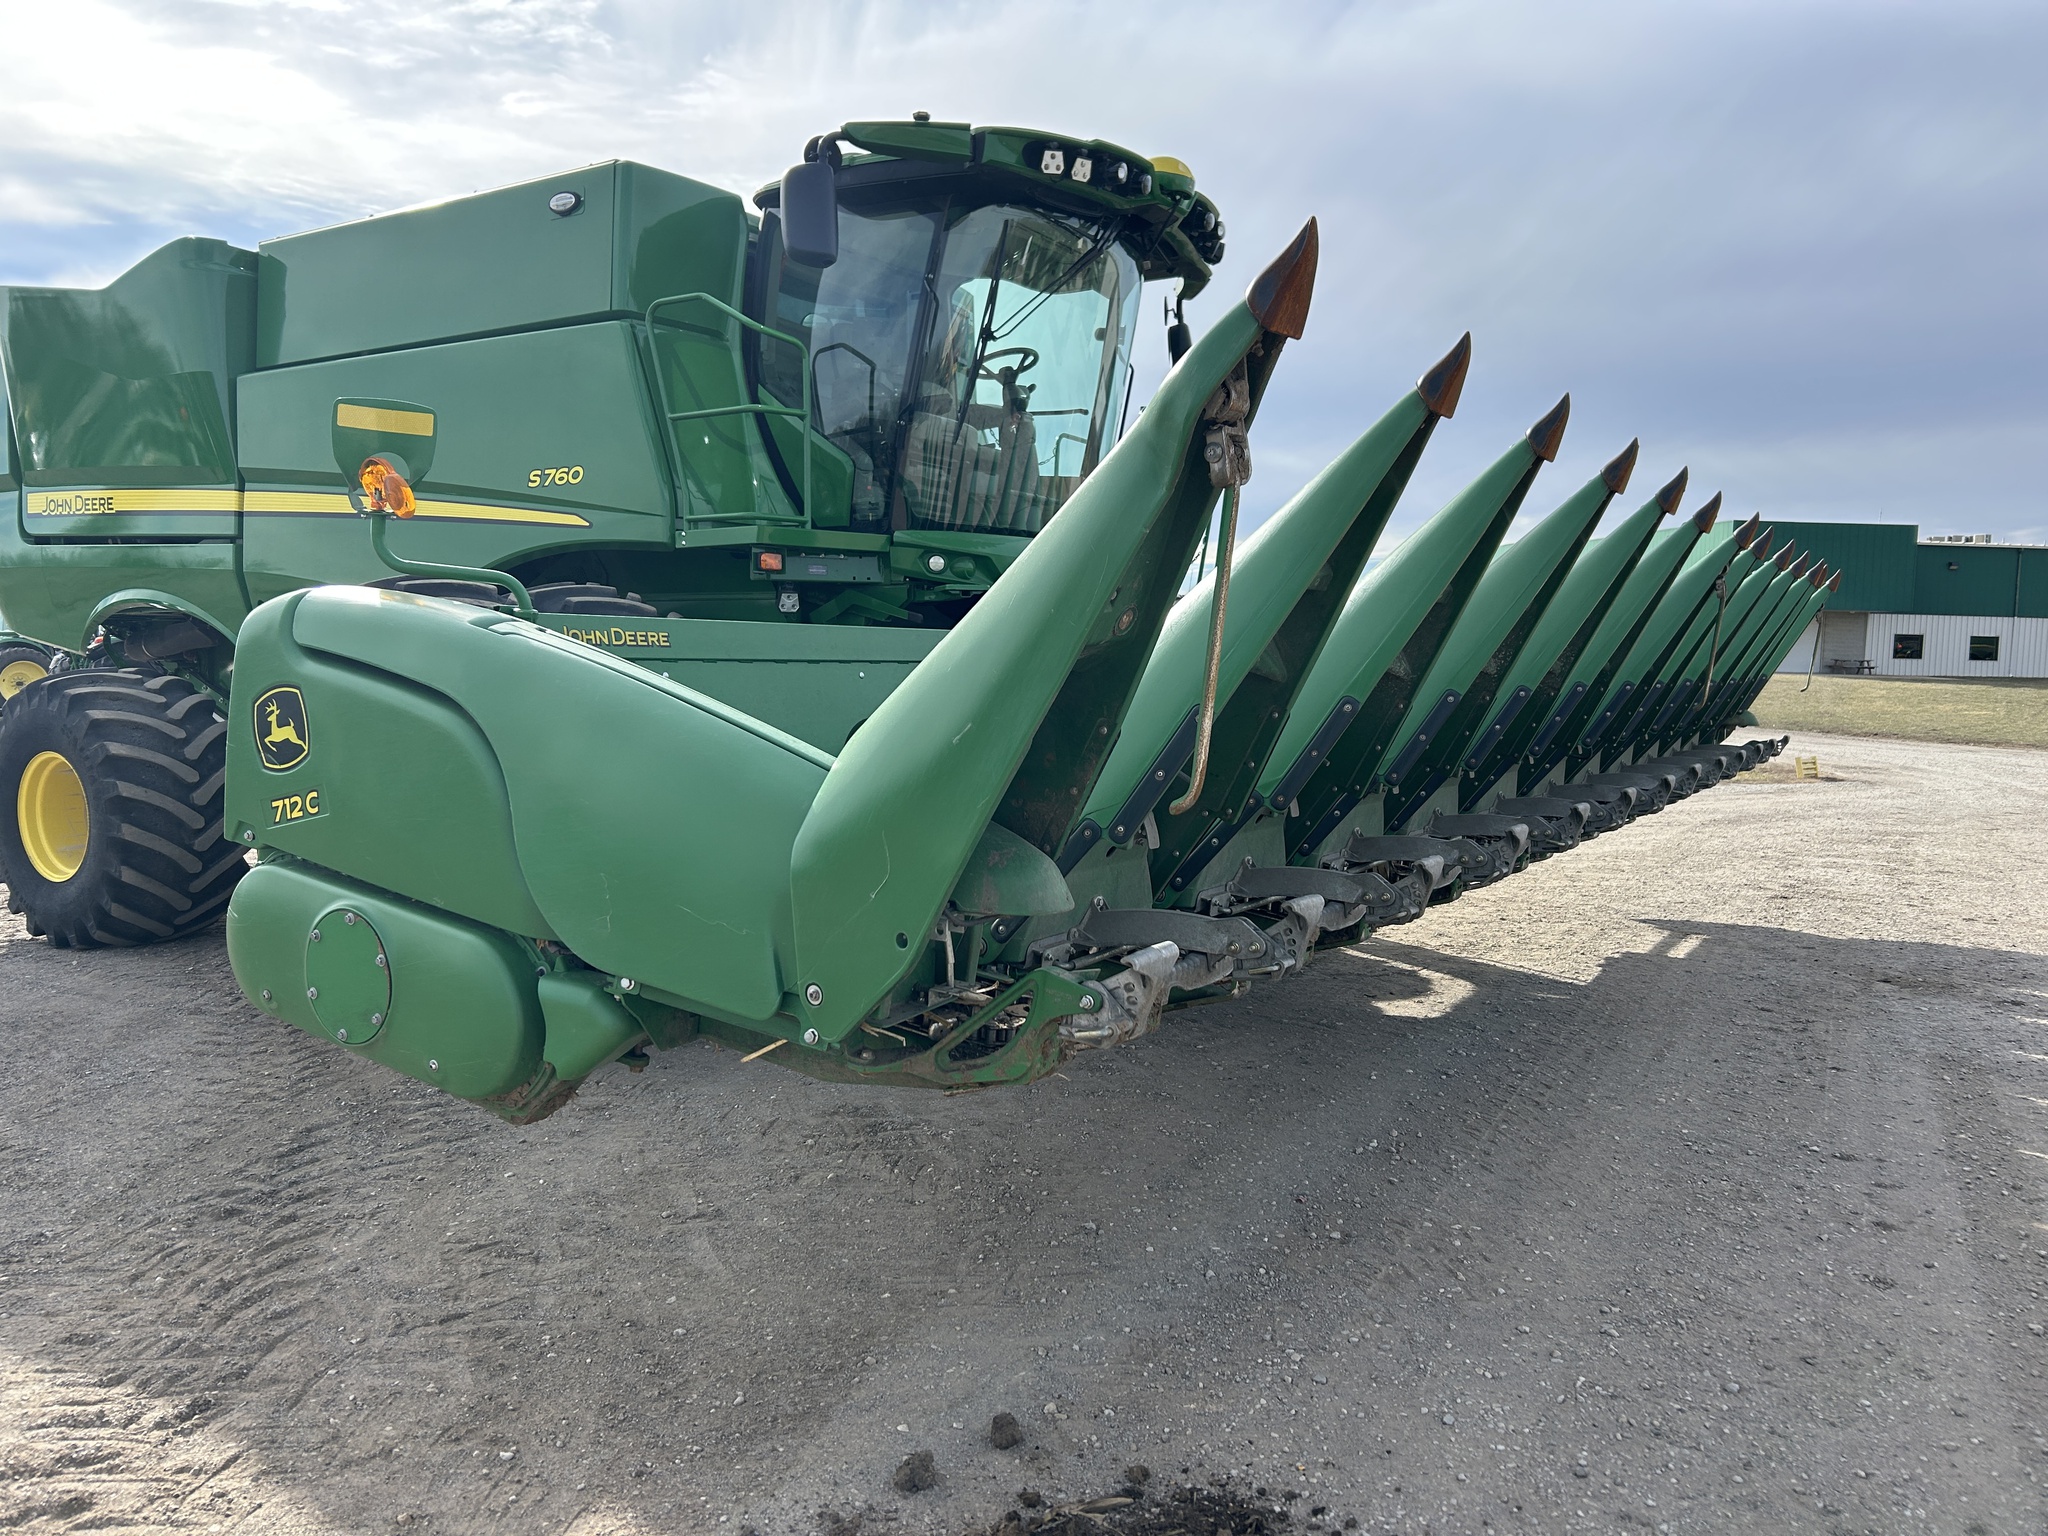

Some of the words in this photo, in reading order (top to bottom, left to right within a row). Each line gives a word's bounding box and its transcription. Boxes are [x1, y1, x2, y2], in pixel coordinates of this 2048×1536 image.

[527, 465, 584, 488] S760
[42, 496, 72, 513] JOHN
[75, 495, 114, 512] DEERE
[610, 627, 671, 647] DEERE
